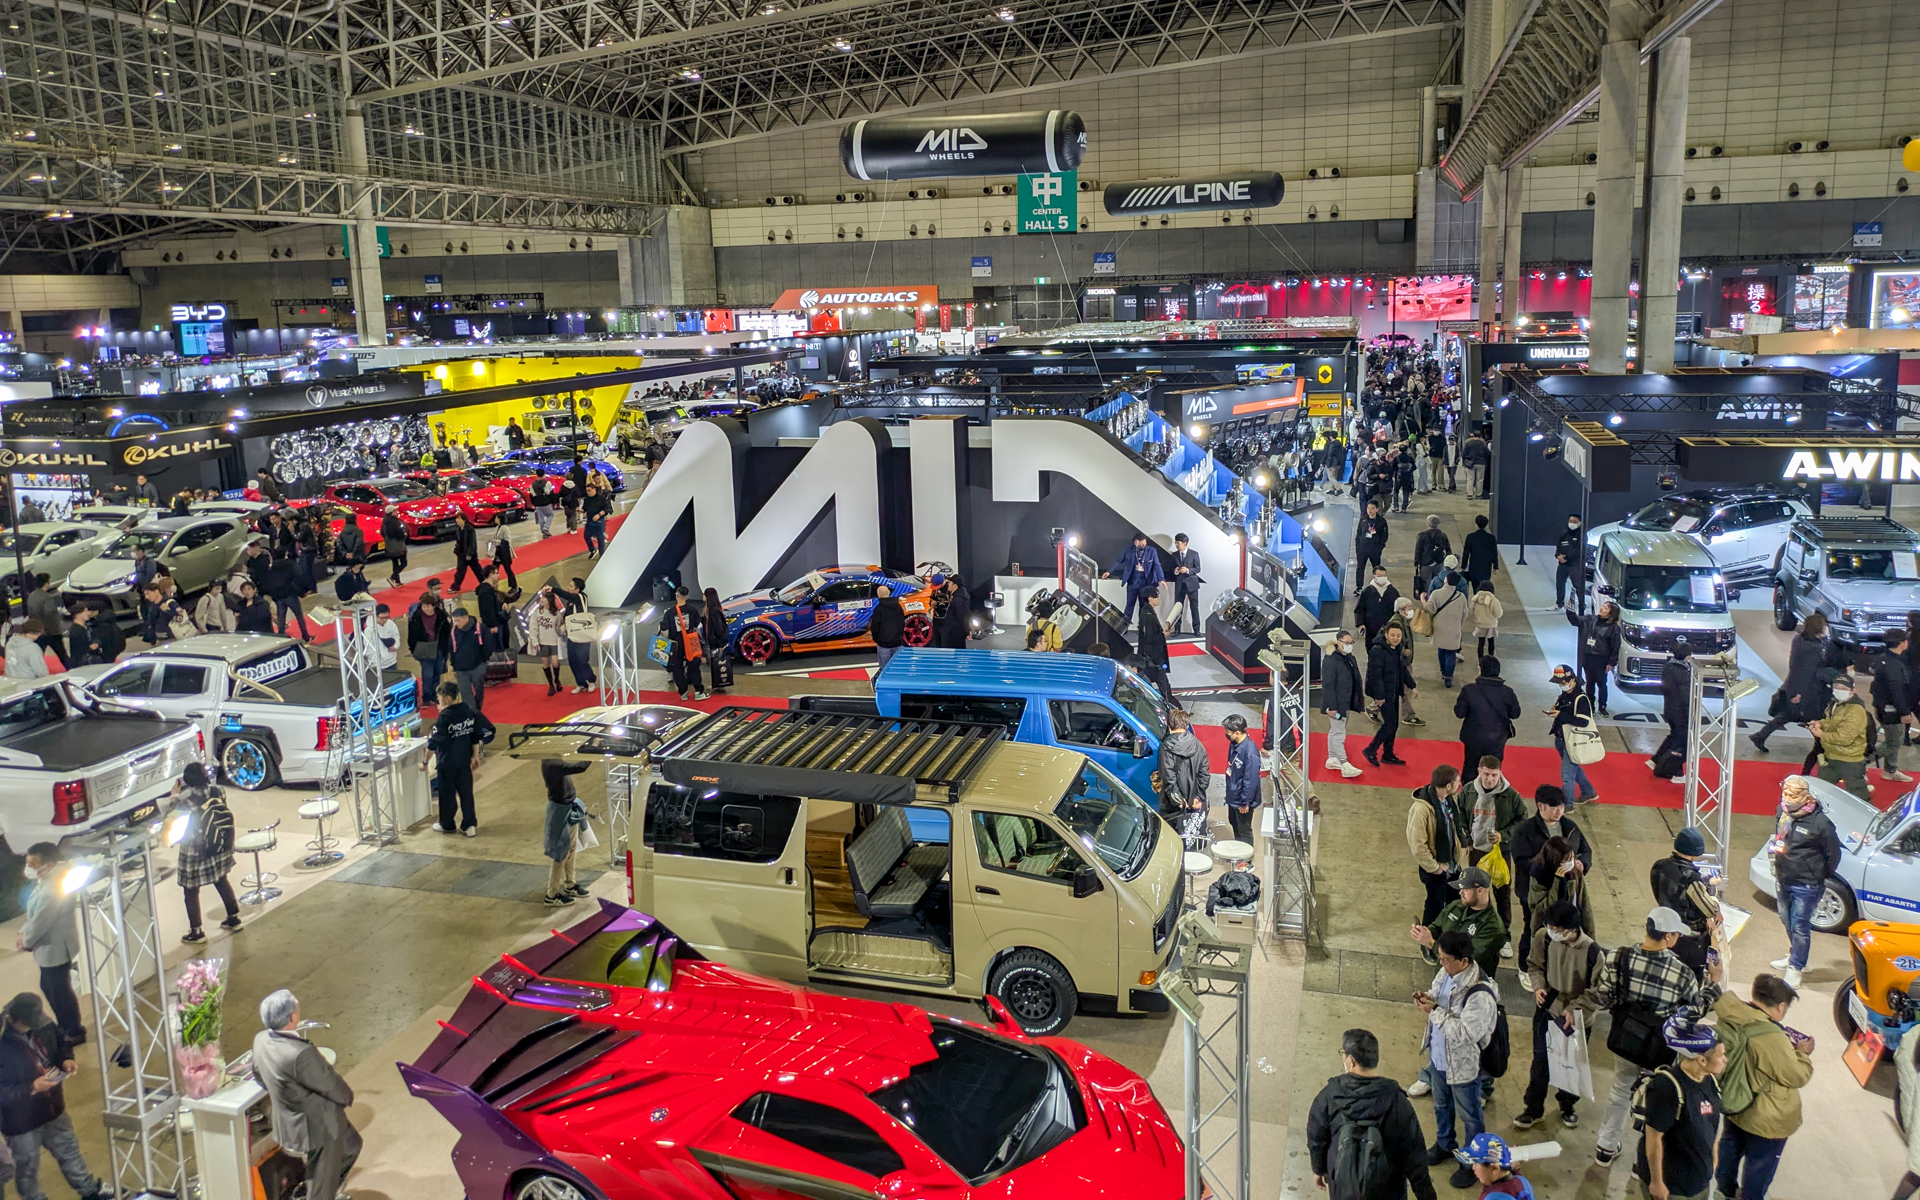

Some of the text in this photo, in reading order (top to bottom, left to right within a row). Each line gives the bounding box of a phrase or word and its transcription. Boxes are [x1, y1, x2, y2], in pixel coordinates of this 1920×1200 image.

[915, 128, 988, 153] MID
[929, 152, 975, 160] WHEELS
[1032, 172, 1062, 205] 中
[1160, 180, 1251, 204] ALPINE
[1025, 216, 1069, 230] HALL 5
[819, 291, 918, 304] AUTOBACS
[1220, 294, 1236, 303] Honda
[1747, 284, 1766, 313] 操る
[171, 305, 226, 321] BYD
[1530, 347, 1589, 358] UNRIVALLED
[1187, 396, 1217, 415] MID
[1192, 413, 1212, 421] WHEELS
[147, 438, 232, 460] KUHL
[17, 453, 107, 466] KUHL
[815, 613, 856, 623] BRZ
[1884, 897, 1916, 909] ABARTH
[1900, 959, 1917, 968] 2R
[1006, 967, 1036, 978] COUNTRY
[1047, 1017, 1061, 1031] TOYO
